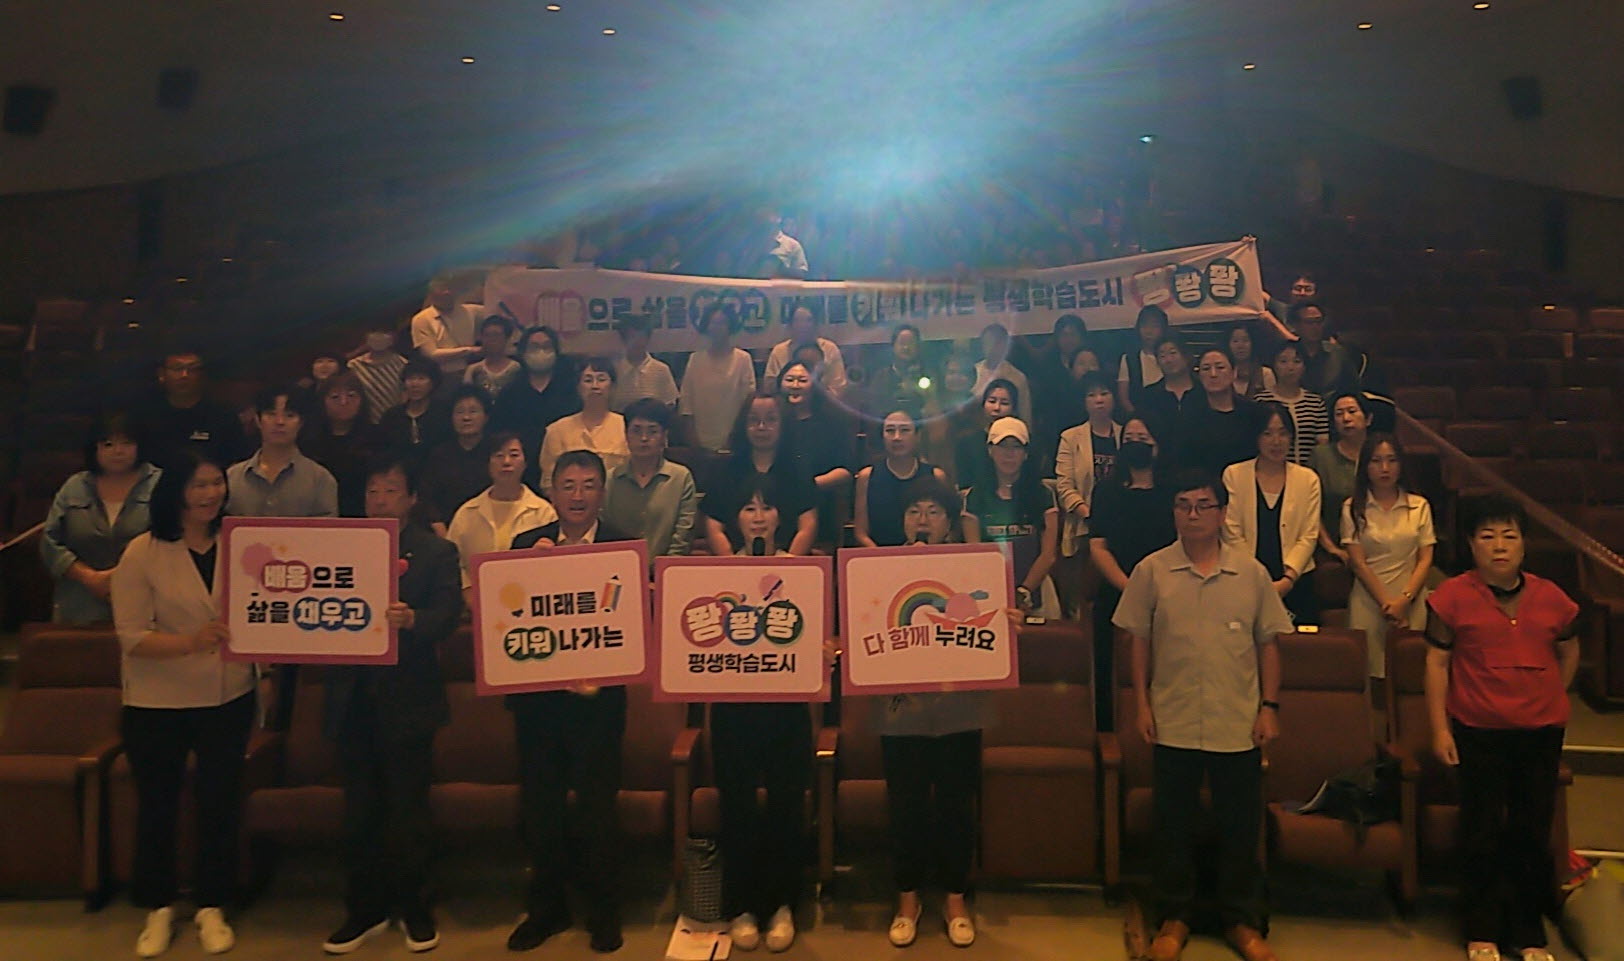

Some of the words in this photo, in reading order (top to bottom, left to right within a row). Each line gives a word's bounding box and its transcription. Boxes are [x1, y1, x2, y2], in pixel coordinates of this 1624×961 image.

[264, 564, 354, 589] 배움으로
[246, 600, 290, 624] 삶을
[296, 600, 366, 626] 채우고
[530, 591, 597, 617] 미래를
[863, 633, 885, 656] 다
[888, 625, 930, 651] 함께
[935, 625, 996, 651] 누려요
[688, 653, 796, 674] 평생학습도시
